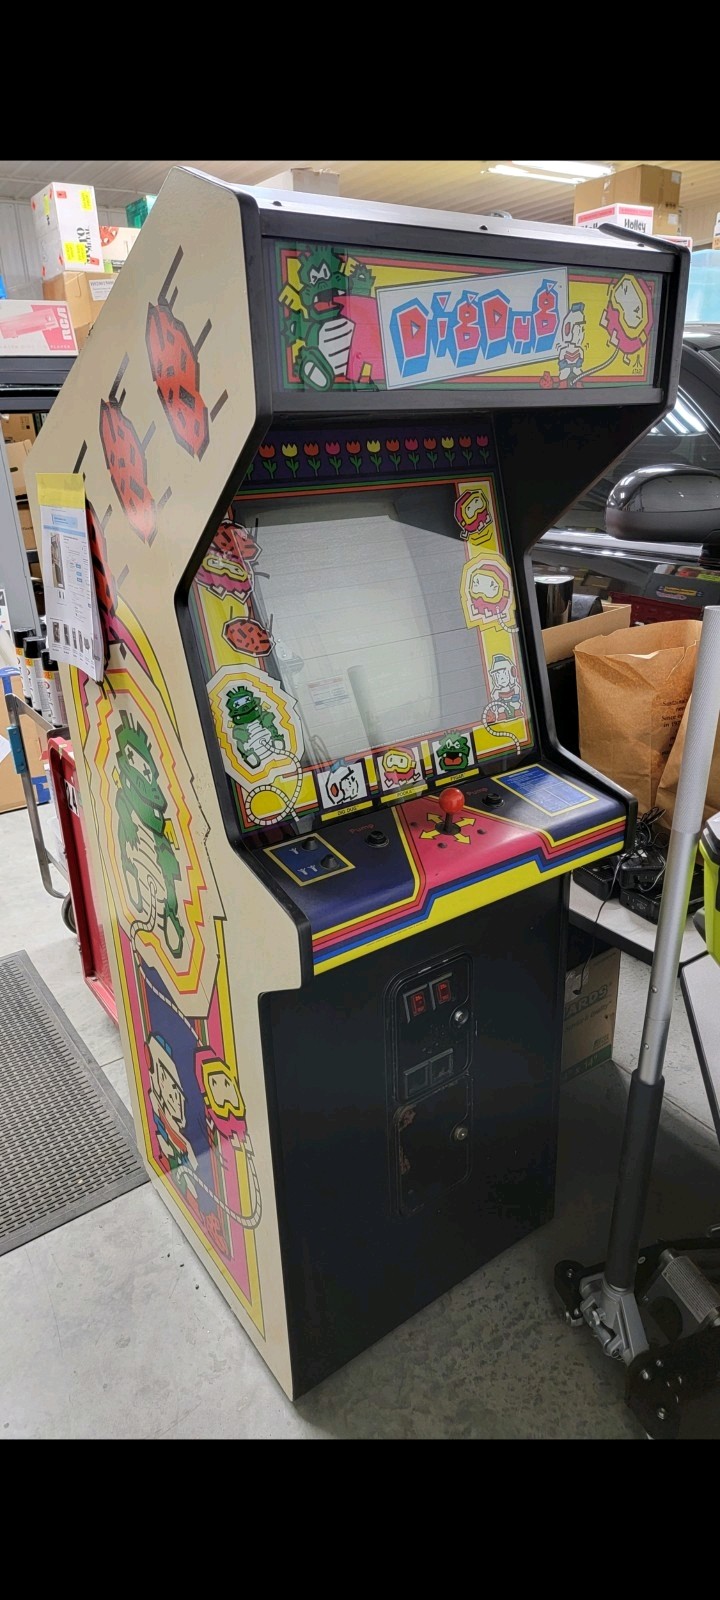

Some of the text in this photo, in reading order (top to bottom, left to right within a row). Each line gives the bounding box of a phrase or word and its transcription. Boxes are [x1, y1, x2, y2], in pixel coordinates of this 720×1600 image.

[623, 218, 647, 233] Holley
[56, 307, 73, 341] RCA
[349, 822, 375, 835] Pump
